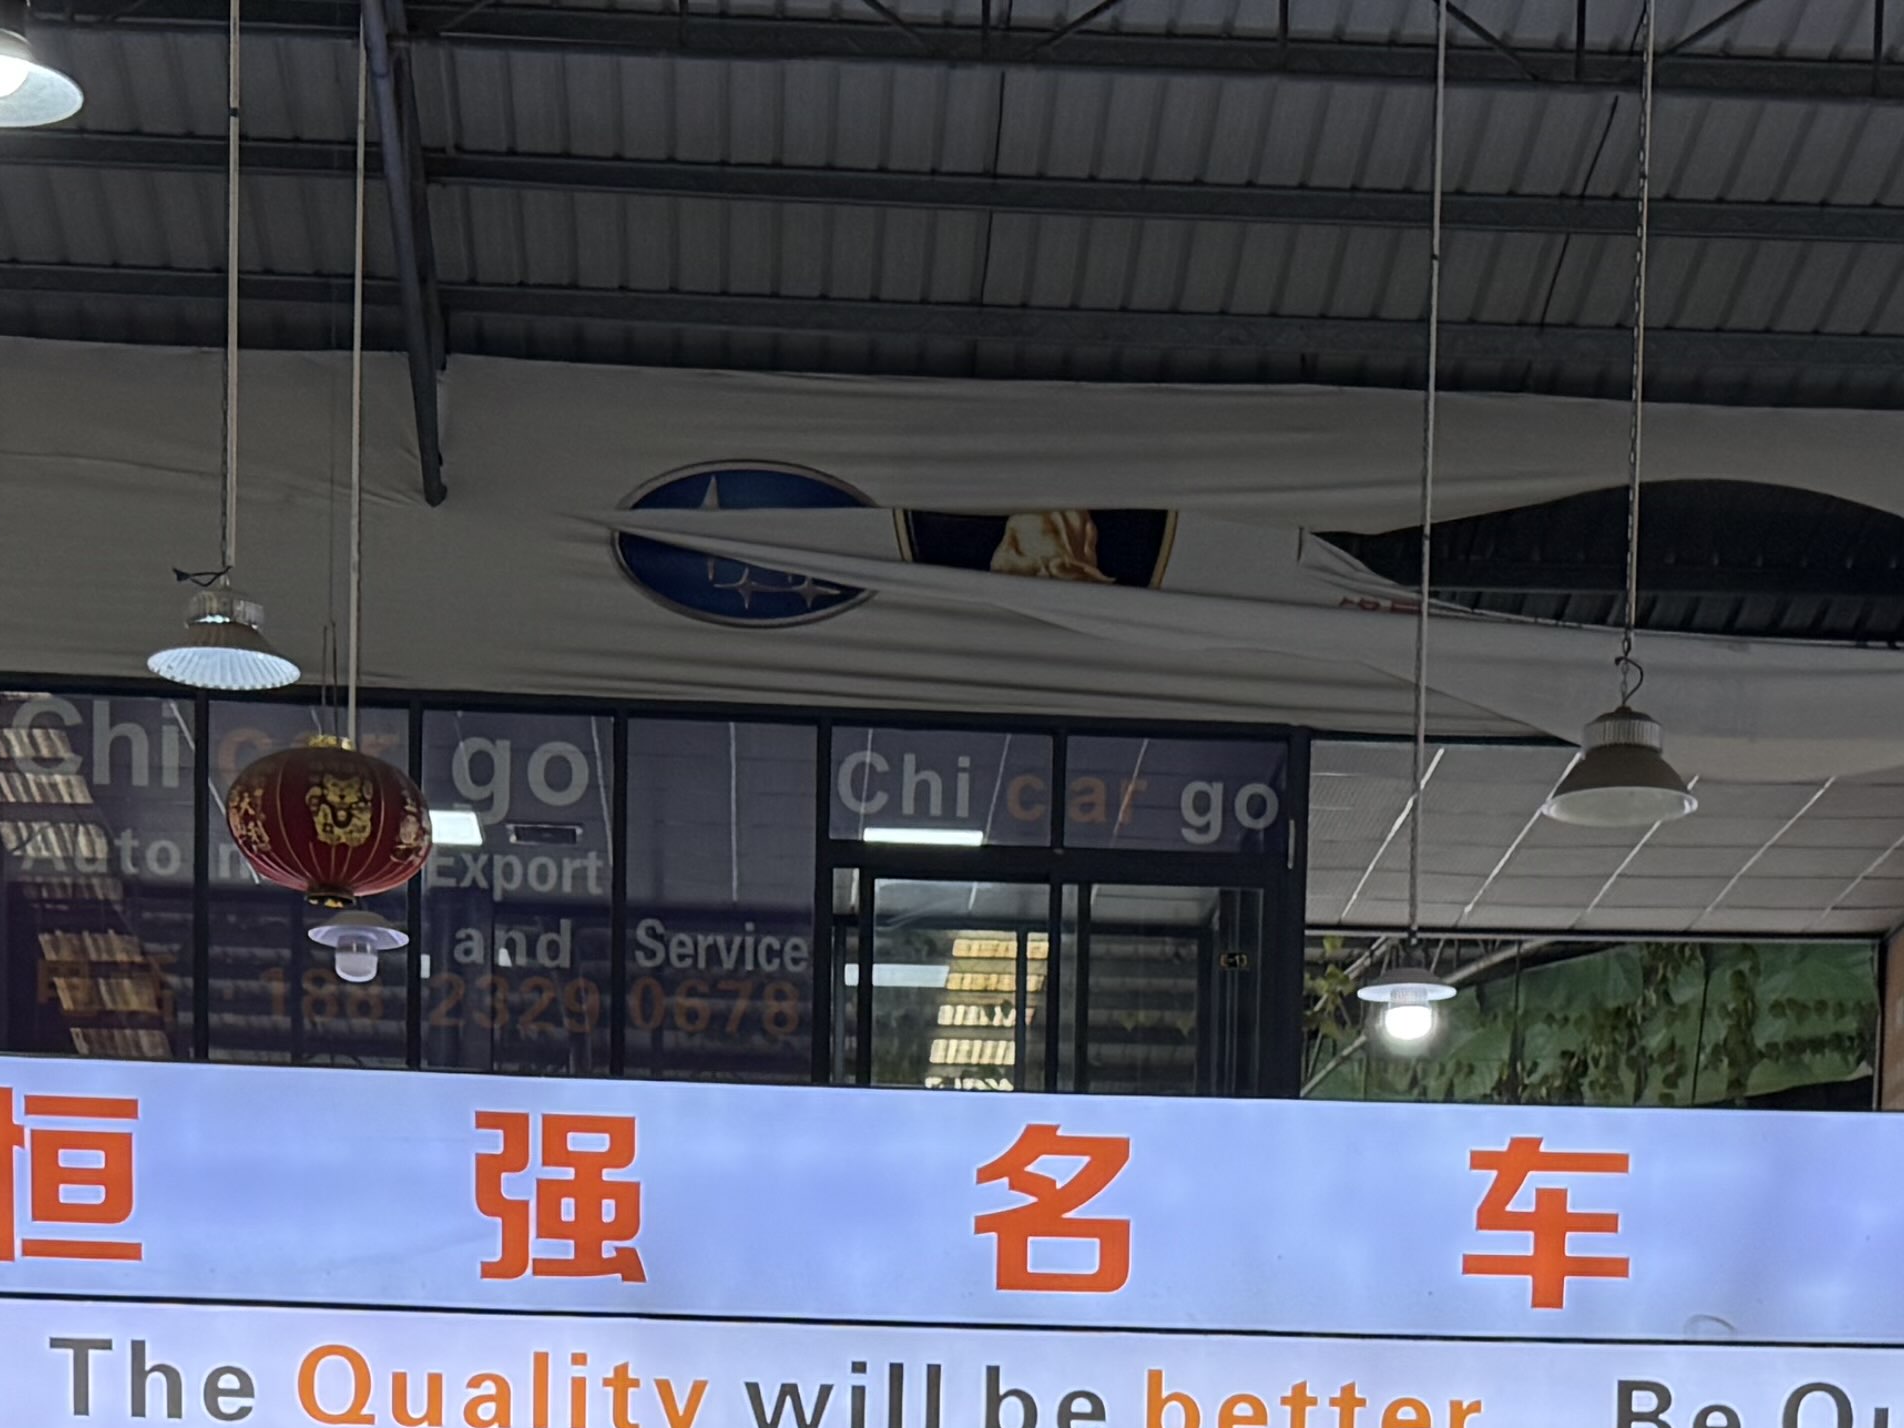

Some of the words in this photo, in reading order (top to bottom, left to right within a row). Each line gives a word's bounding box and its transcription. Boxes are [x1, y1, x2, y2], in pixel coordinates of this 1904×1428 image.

[427, 850, 606, 903] Export
[454, 919, 572, 970] and
[634, 917, 809, 973] Service
[430, 973, 601, 1035] 2329
[627, 975, 800, 1037] 0678
[50, 1338, 254, 1421] The
